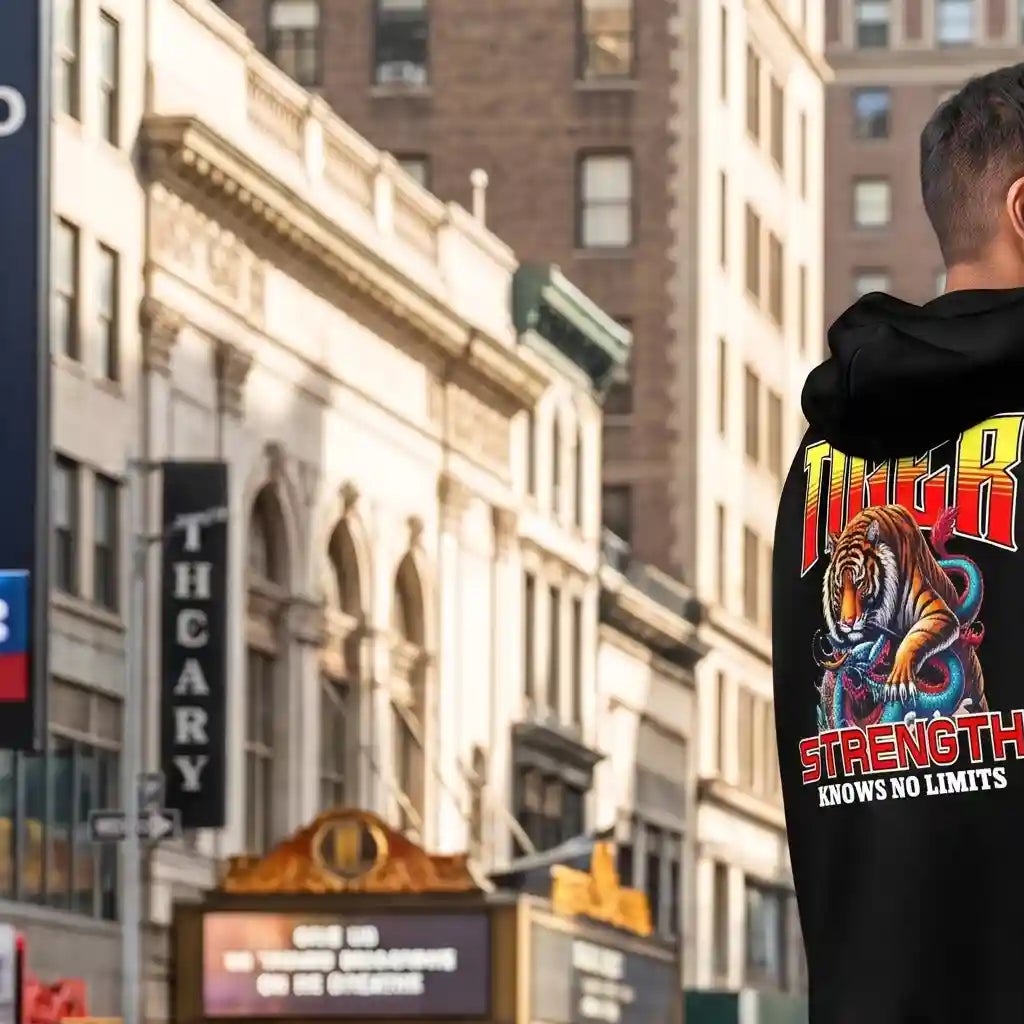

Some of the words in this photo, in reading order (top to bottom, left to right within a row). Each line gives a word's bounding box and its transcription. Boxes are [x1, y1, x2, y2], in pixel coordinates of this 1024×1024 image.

[817, 778, 888, 808] KNOWS
[889, 774, 921, 800] NO
[924, 766, 1008, 796] LIMITS
